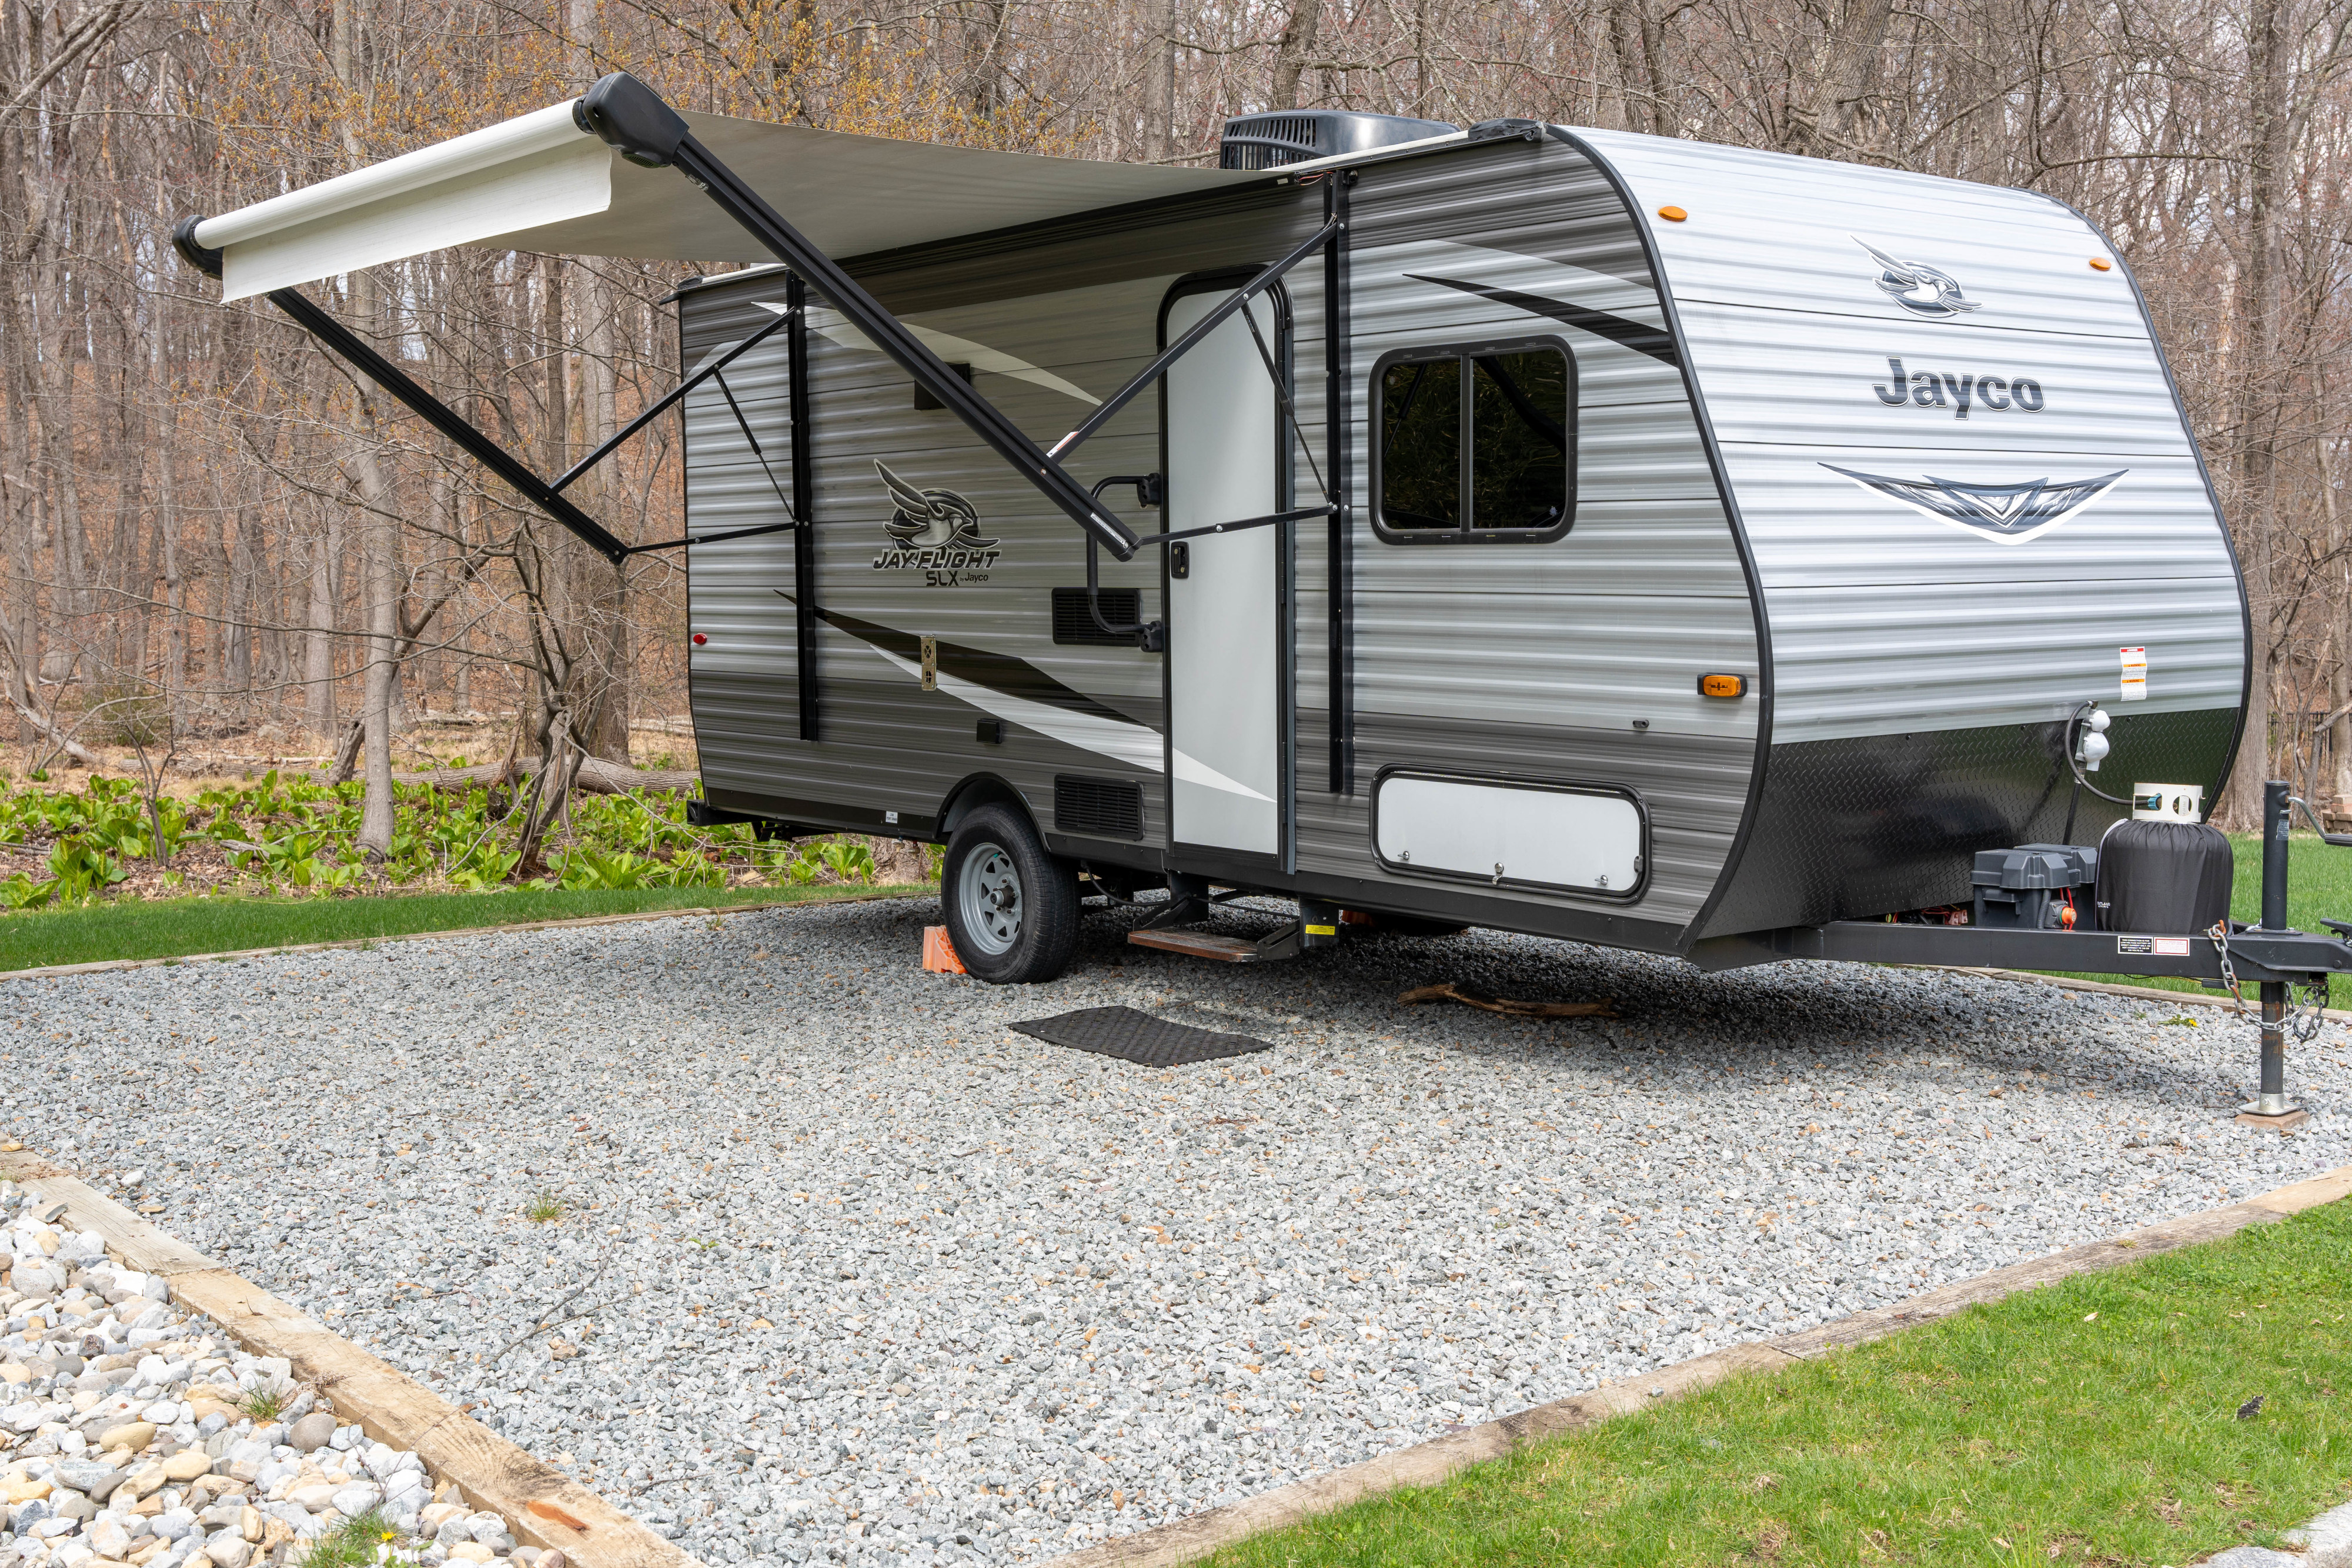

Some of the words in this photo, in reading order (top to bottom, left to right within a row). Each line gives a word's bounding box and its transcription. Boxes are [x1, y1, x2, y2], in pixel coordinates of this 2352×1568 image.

[1872, 356, 2046, 420] Jayco
[873, 549, 916, 570] JAY
[914, 549, 1002, 570] FLIGHT
[926, 570, 959, 586] SLX
[965, 573, 988, 583] Jayco
